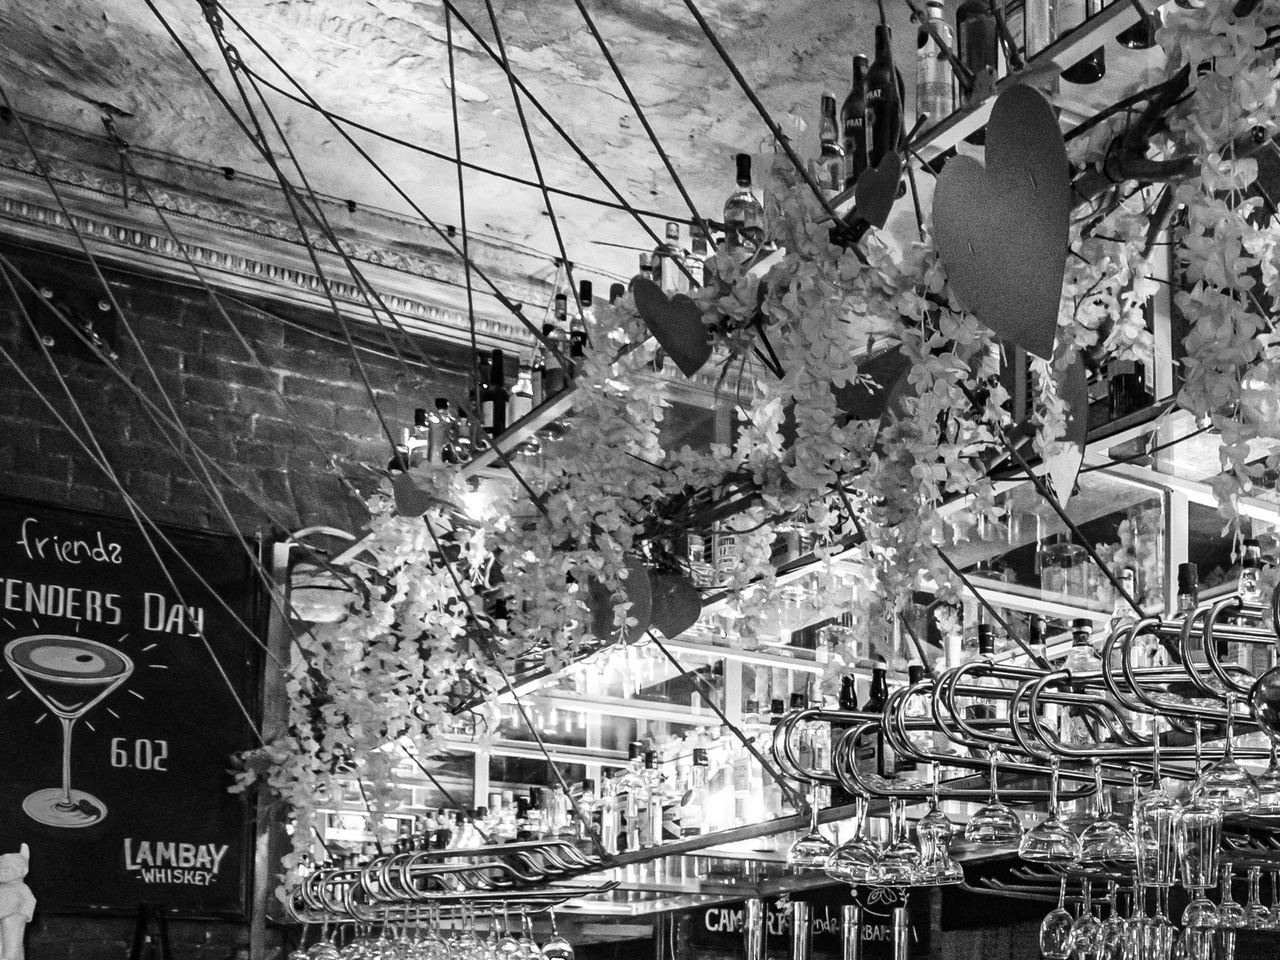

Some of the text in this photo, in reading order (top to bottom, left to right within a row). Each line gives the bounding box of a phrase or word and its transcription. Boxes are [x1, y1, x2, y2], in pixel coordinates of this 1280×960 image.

[16, 517, 123, 564] friends
[0, 577, 204, 637] ENDERS DAY
[111, 737, 168, 772] 6.02
[124, 838, 229, 874] LAMBAY
